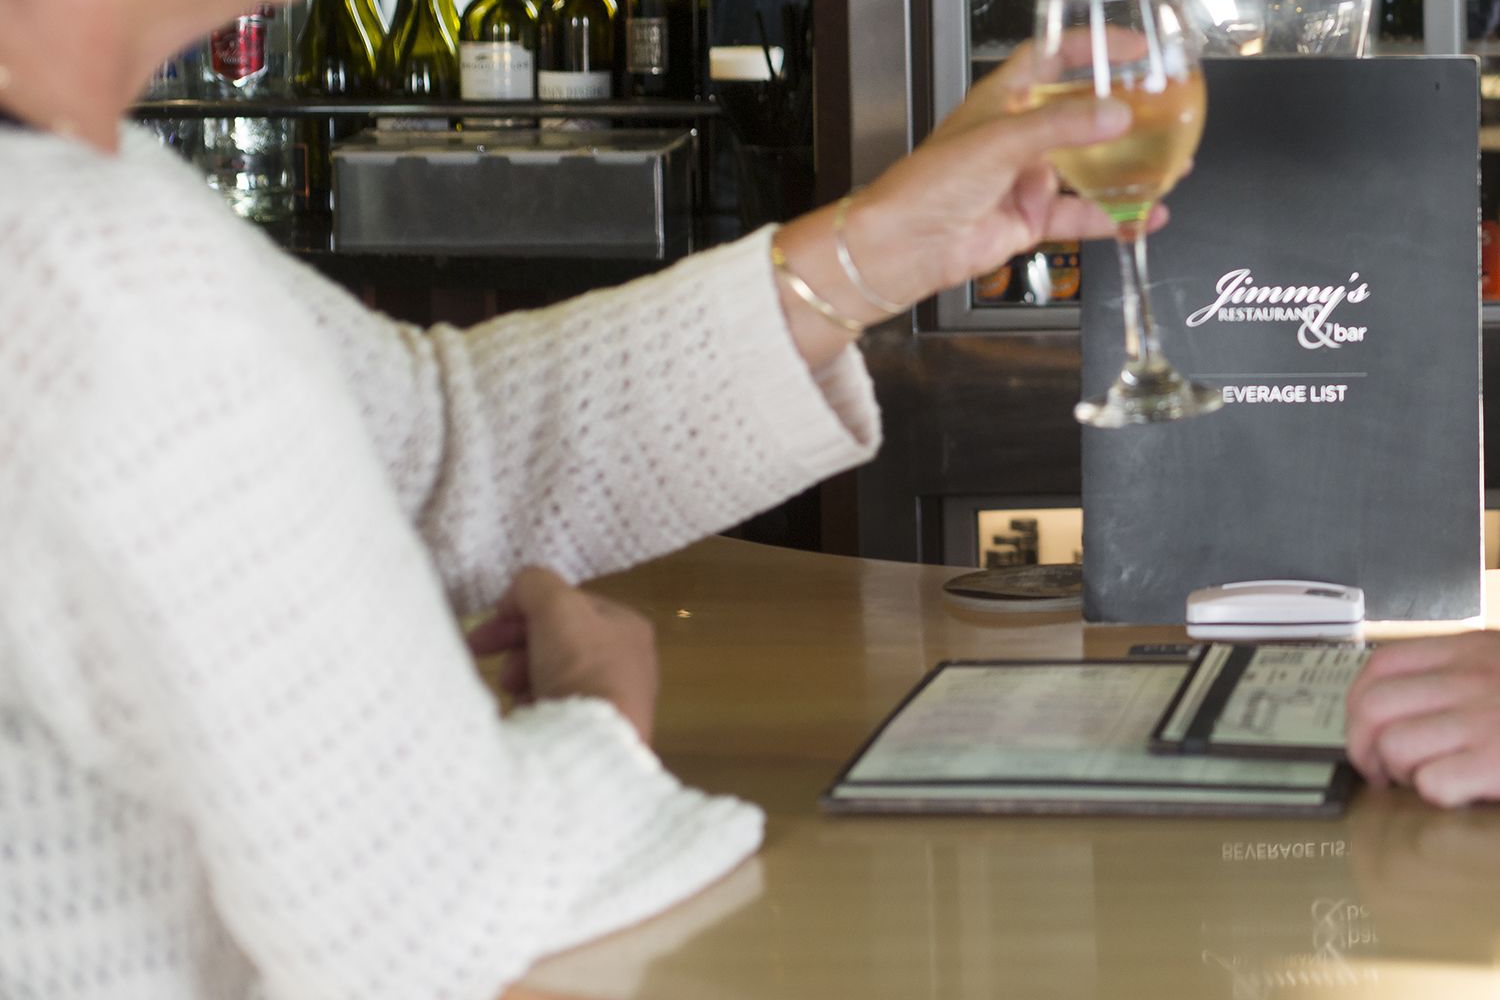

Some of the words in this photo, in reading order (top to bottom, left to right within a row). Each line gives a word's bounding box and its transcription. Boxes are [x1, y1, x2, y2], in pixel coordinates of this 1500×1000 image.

[1186, 268, 1371, 331] Jimmy's
[1218, 306, 1318, 322] RESTAURANT
[1297, 304, 1342, 349] &
[1333, 323, 1367, 342] bar
[1222, 385, 1307, 403] EVERAGE
[1310, 384, 1348, 403] LIST
